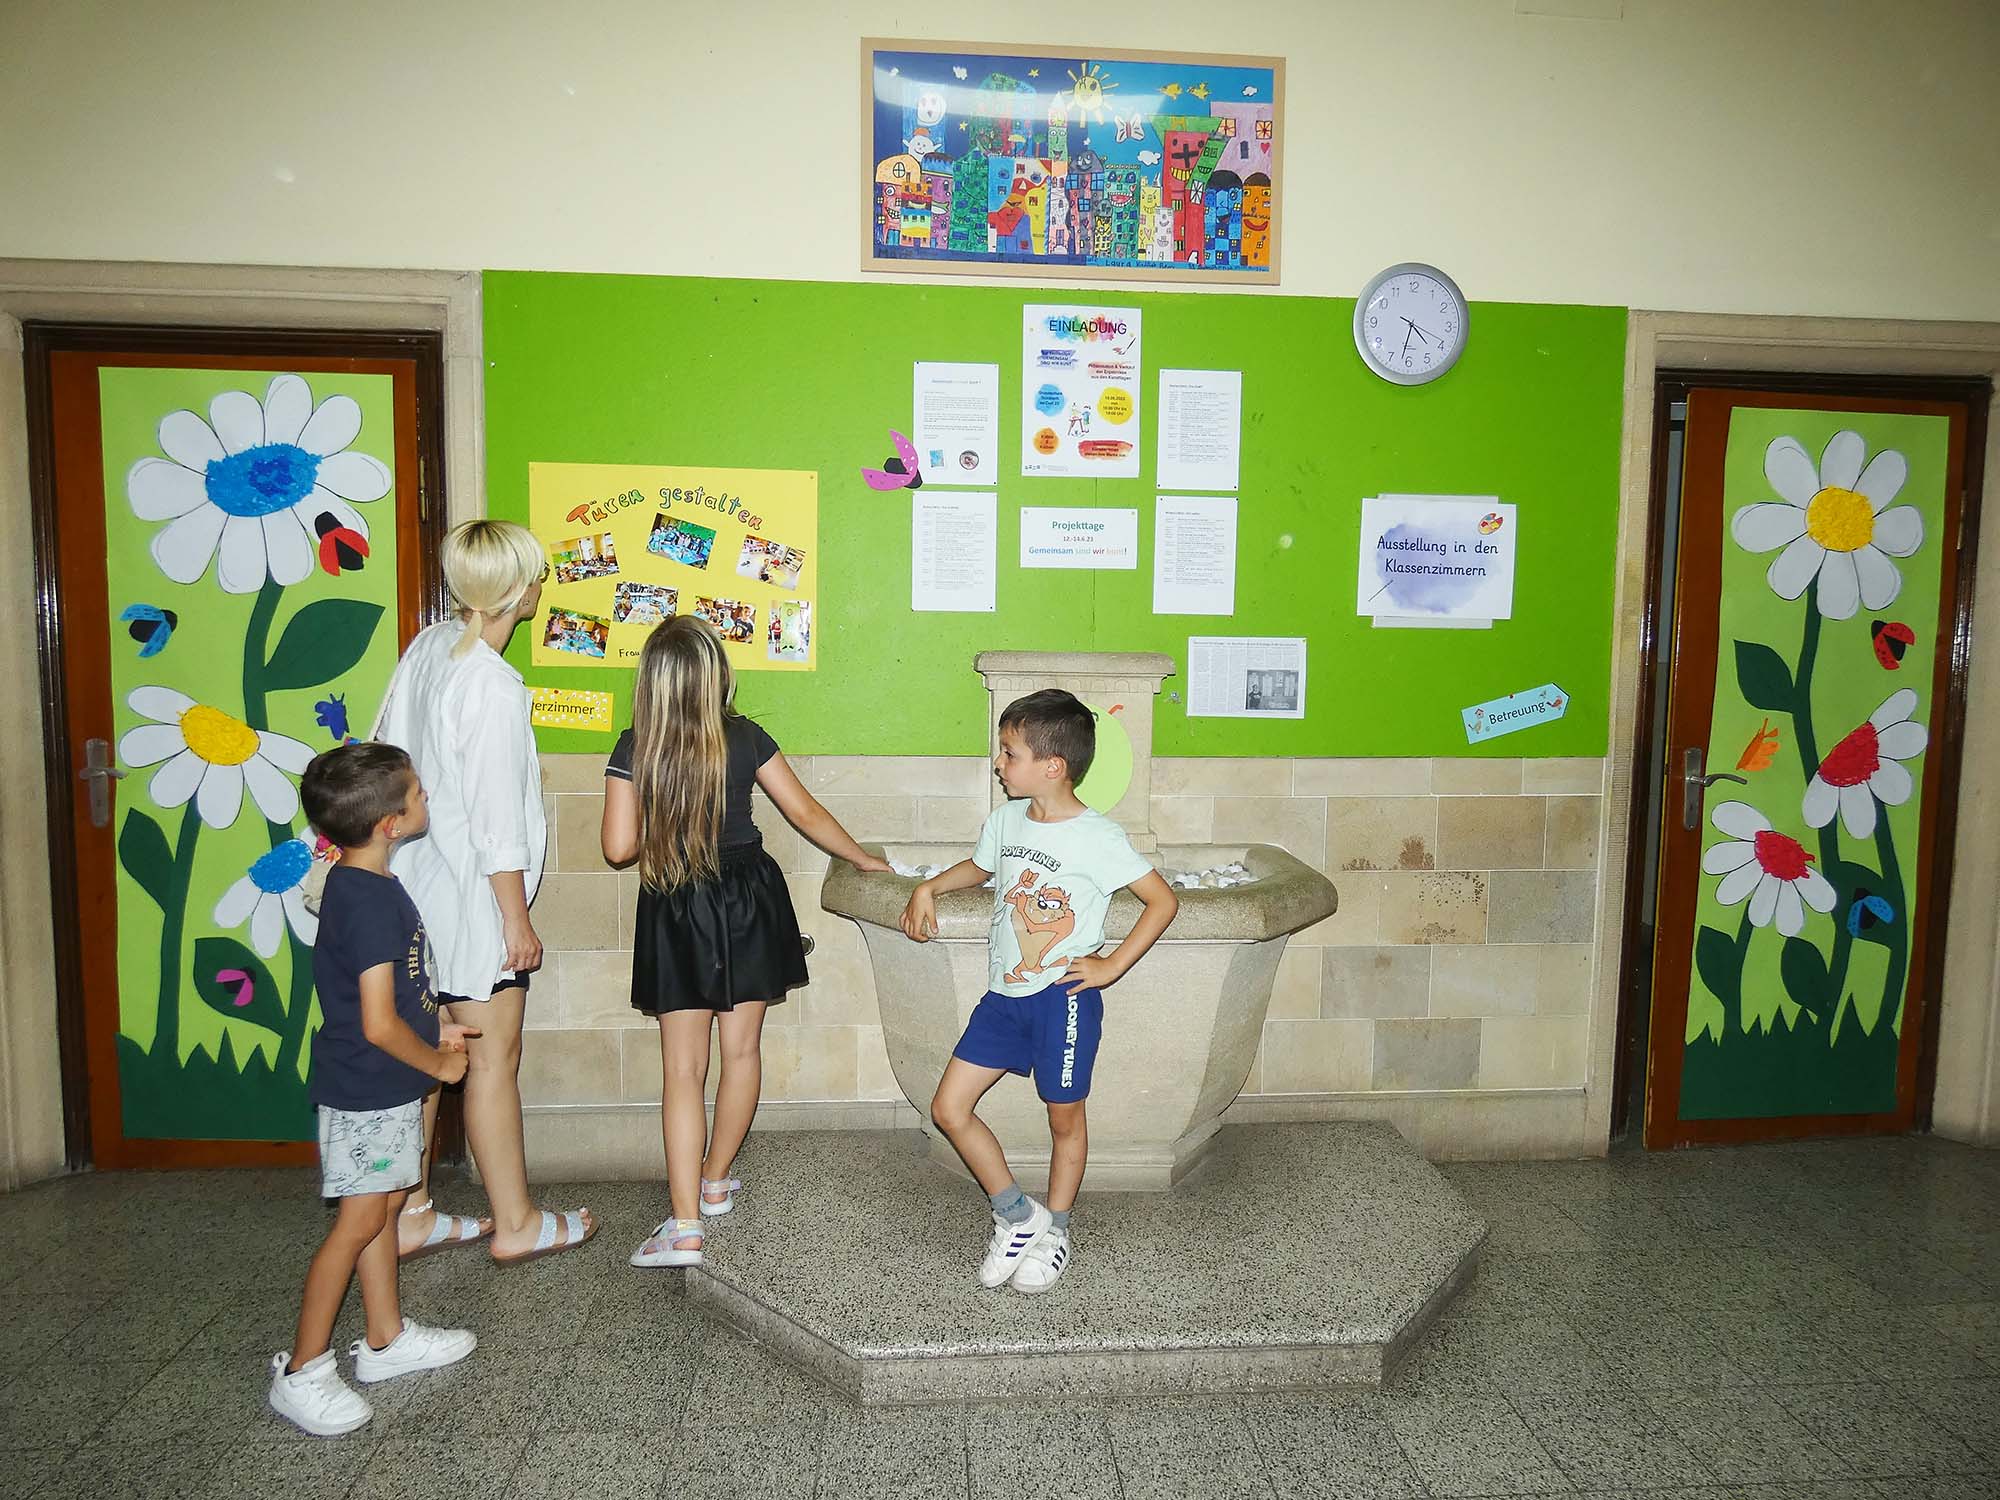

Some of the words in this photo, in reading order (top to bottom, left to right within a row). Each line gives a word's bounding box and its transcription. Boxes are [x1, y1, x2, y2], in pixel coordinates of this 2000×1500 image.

[1392, 288, 1400, 297] 11
[1410, 281, 1420, 294] 12
[1378, 298, 1389, 310] 10
[1440, 302, 1448, 314] 2
[1049, 319, 1127, 334] EINLADUNG
[1370, 316, 1378, 328] 9
[1444, 321, 1452, 333] 3
[1437, 340, 1445, 352] 4
[1388, 352, 1395, 362] 7
[1404, 356, 1413, 368] 6
[1424, 352, 1431, 364] 5
[566, 488, 645, 527] Türen
[659, 485, 763, 531] gestalten
[1052, 520, 1104, 532] Projekttage
[1028, 546, 1074, 554] Gemeinsam
[1092, 547, 1104, 555] wir
[1377, 536, 1447, 556] Ausstellung
[1454, 541, 1467, 553] in
[1474, 540, 1498, 554] den
[1384, 558, 1486, 576] Klassenzimmern
[618, 649, 640, 658] Frau
[1489, 700, 1546, 724] Betreuung
[1001, 846, 1031, 858] OONEY
[1028, 850, 1061, 872] TUNES
[1061, 1048, 1075, 1088] TUNES
